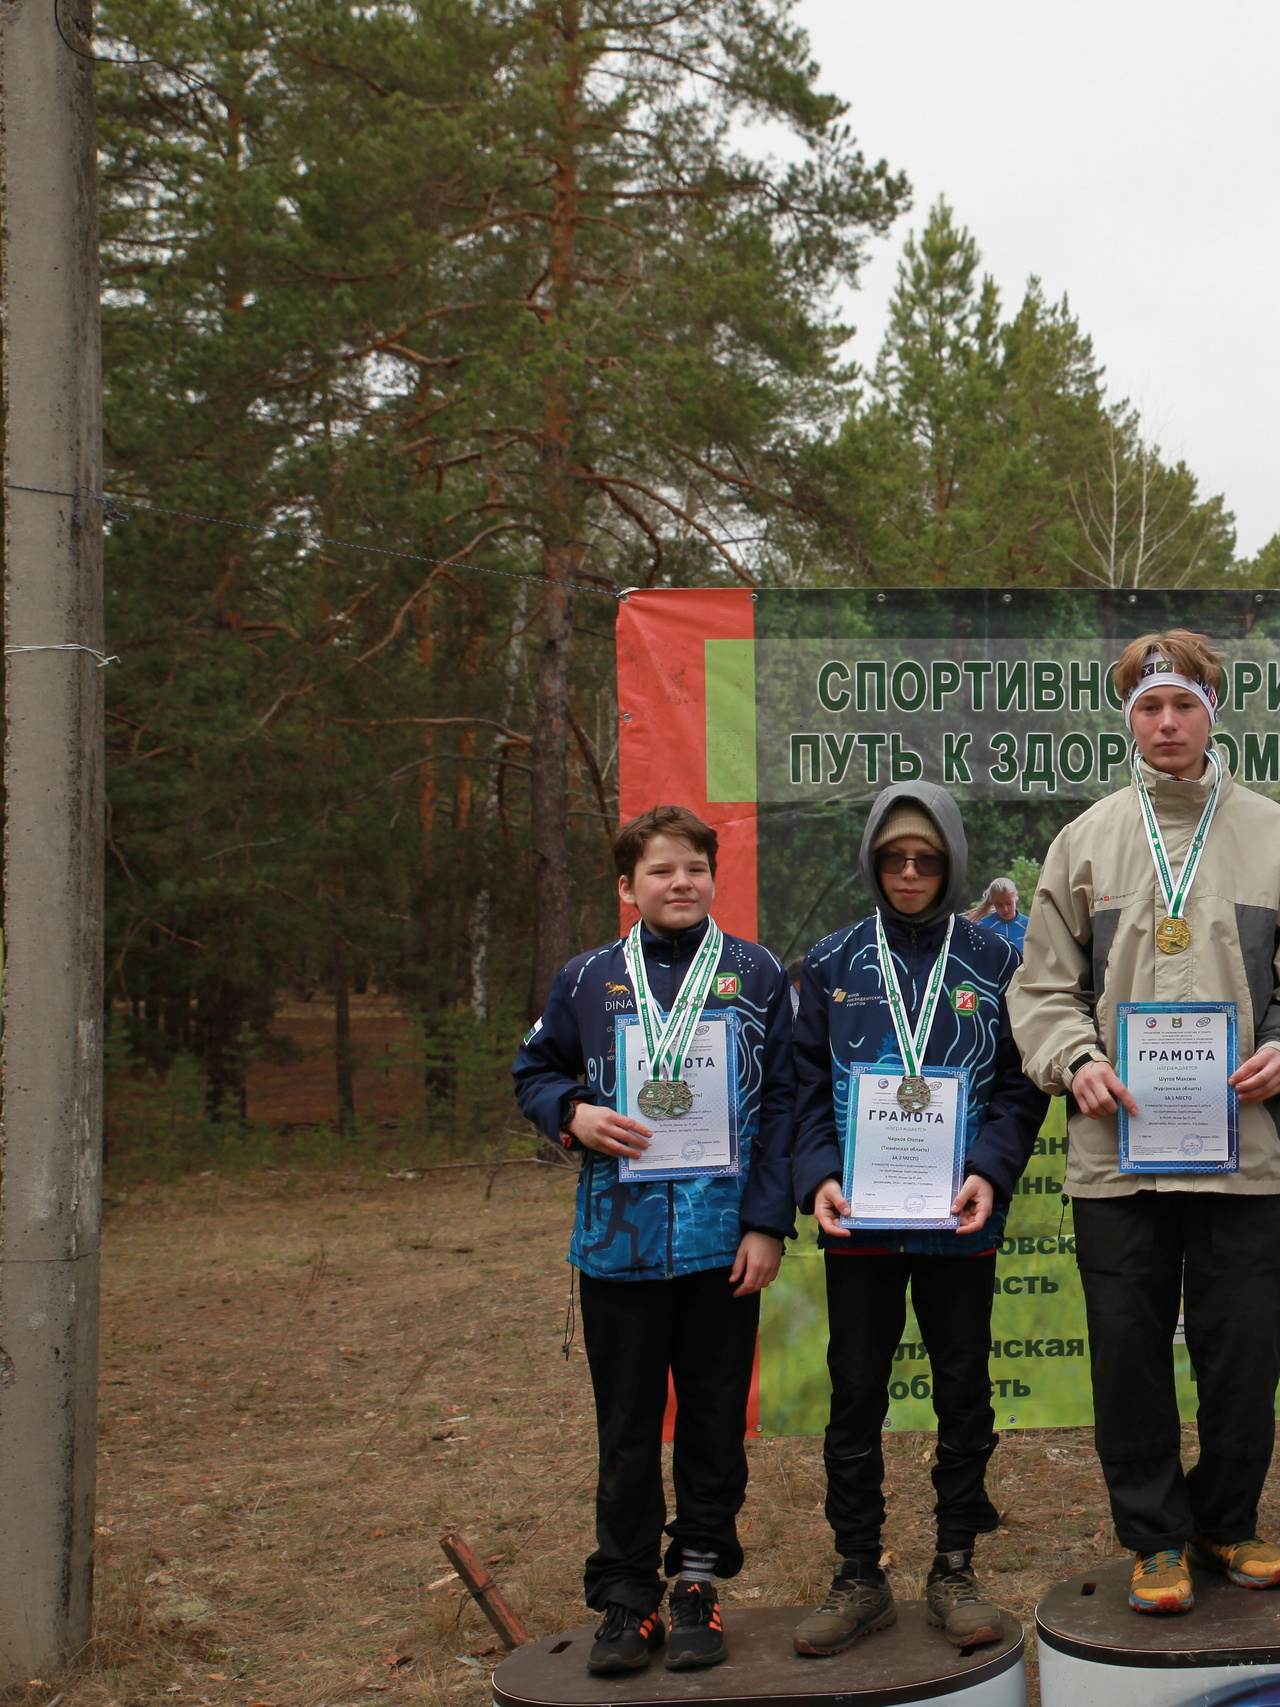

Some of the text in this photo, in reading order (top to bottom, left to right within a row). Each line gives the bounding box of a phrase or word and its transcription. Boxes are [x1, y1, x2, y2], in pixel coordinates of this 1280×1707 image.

[817, 660, 1124, 712] СПОРТИВН
[790, 733, 924, 783] ПУТЬ
[943, 733, 973, 783] К
[604, 999, 634, 1011] DINA
[1139, 1050, 1215, 1061] ГРАМОТА
[638, 1057, 715, 1070] ГОТА
[869, 1110, 944, 1123] ГРАМОТА
